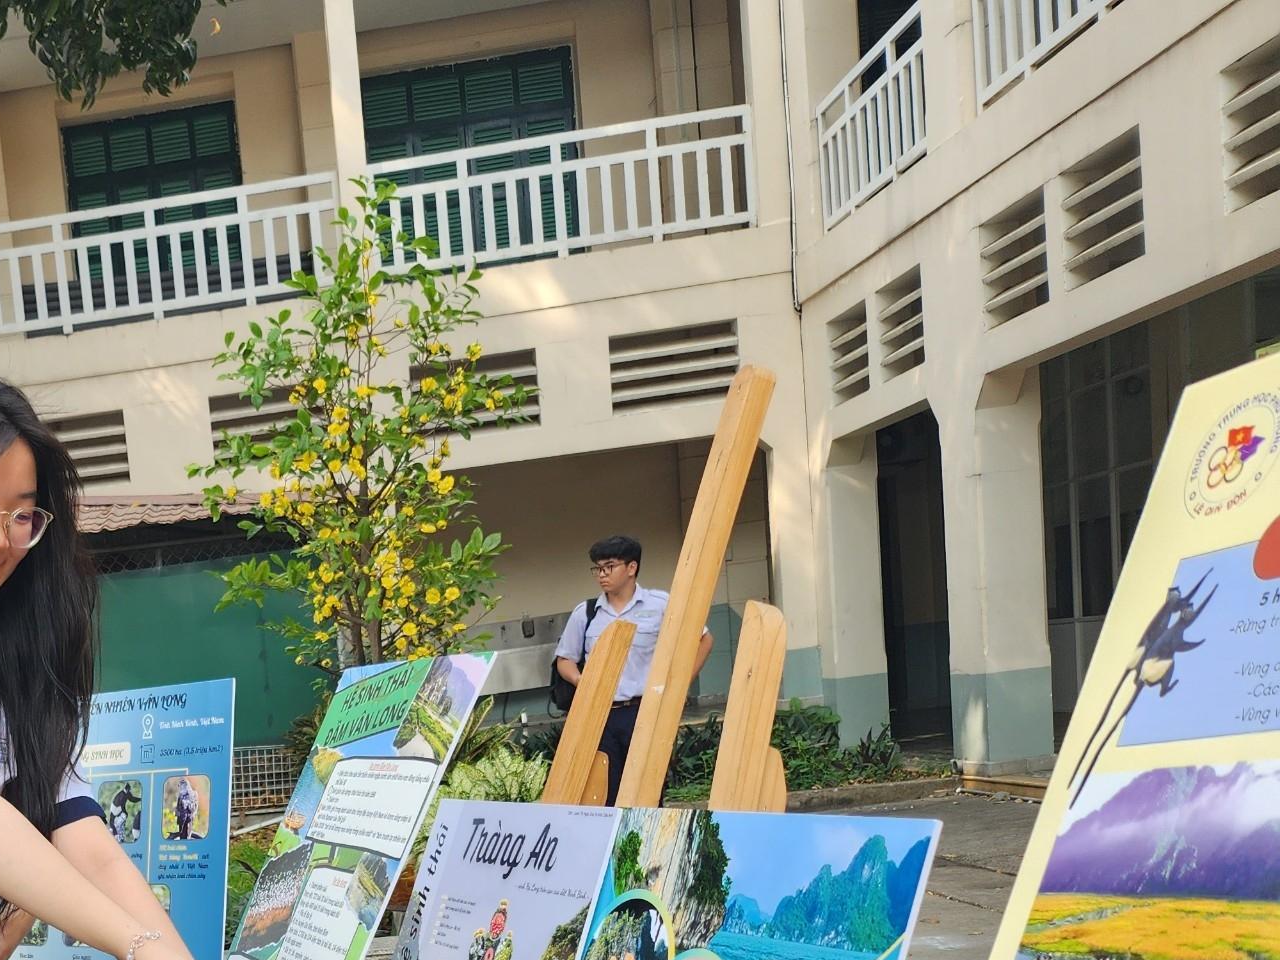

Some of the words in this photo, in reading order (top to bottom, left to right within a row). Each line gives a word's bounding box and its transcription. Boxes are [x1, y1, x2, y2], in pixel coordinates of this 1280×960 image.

[1260, 592, 1270, 606] 5
[160, 692, 188, 711] LONG
[355, 679, 384, 706] SINH
[372, 700, 408, 729] LONG
[463, 818, 526, 879] Tràng
[524, 822, 559, 872] An
[410, 886, 430, 939] sinh
[428, 824, 449, 876] thái
